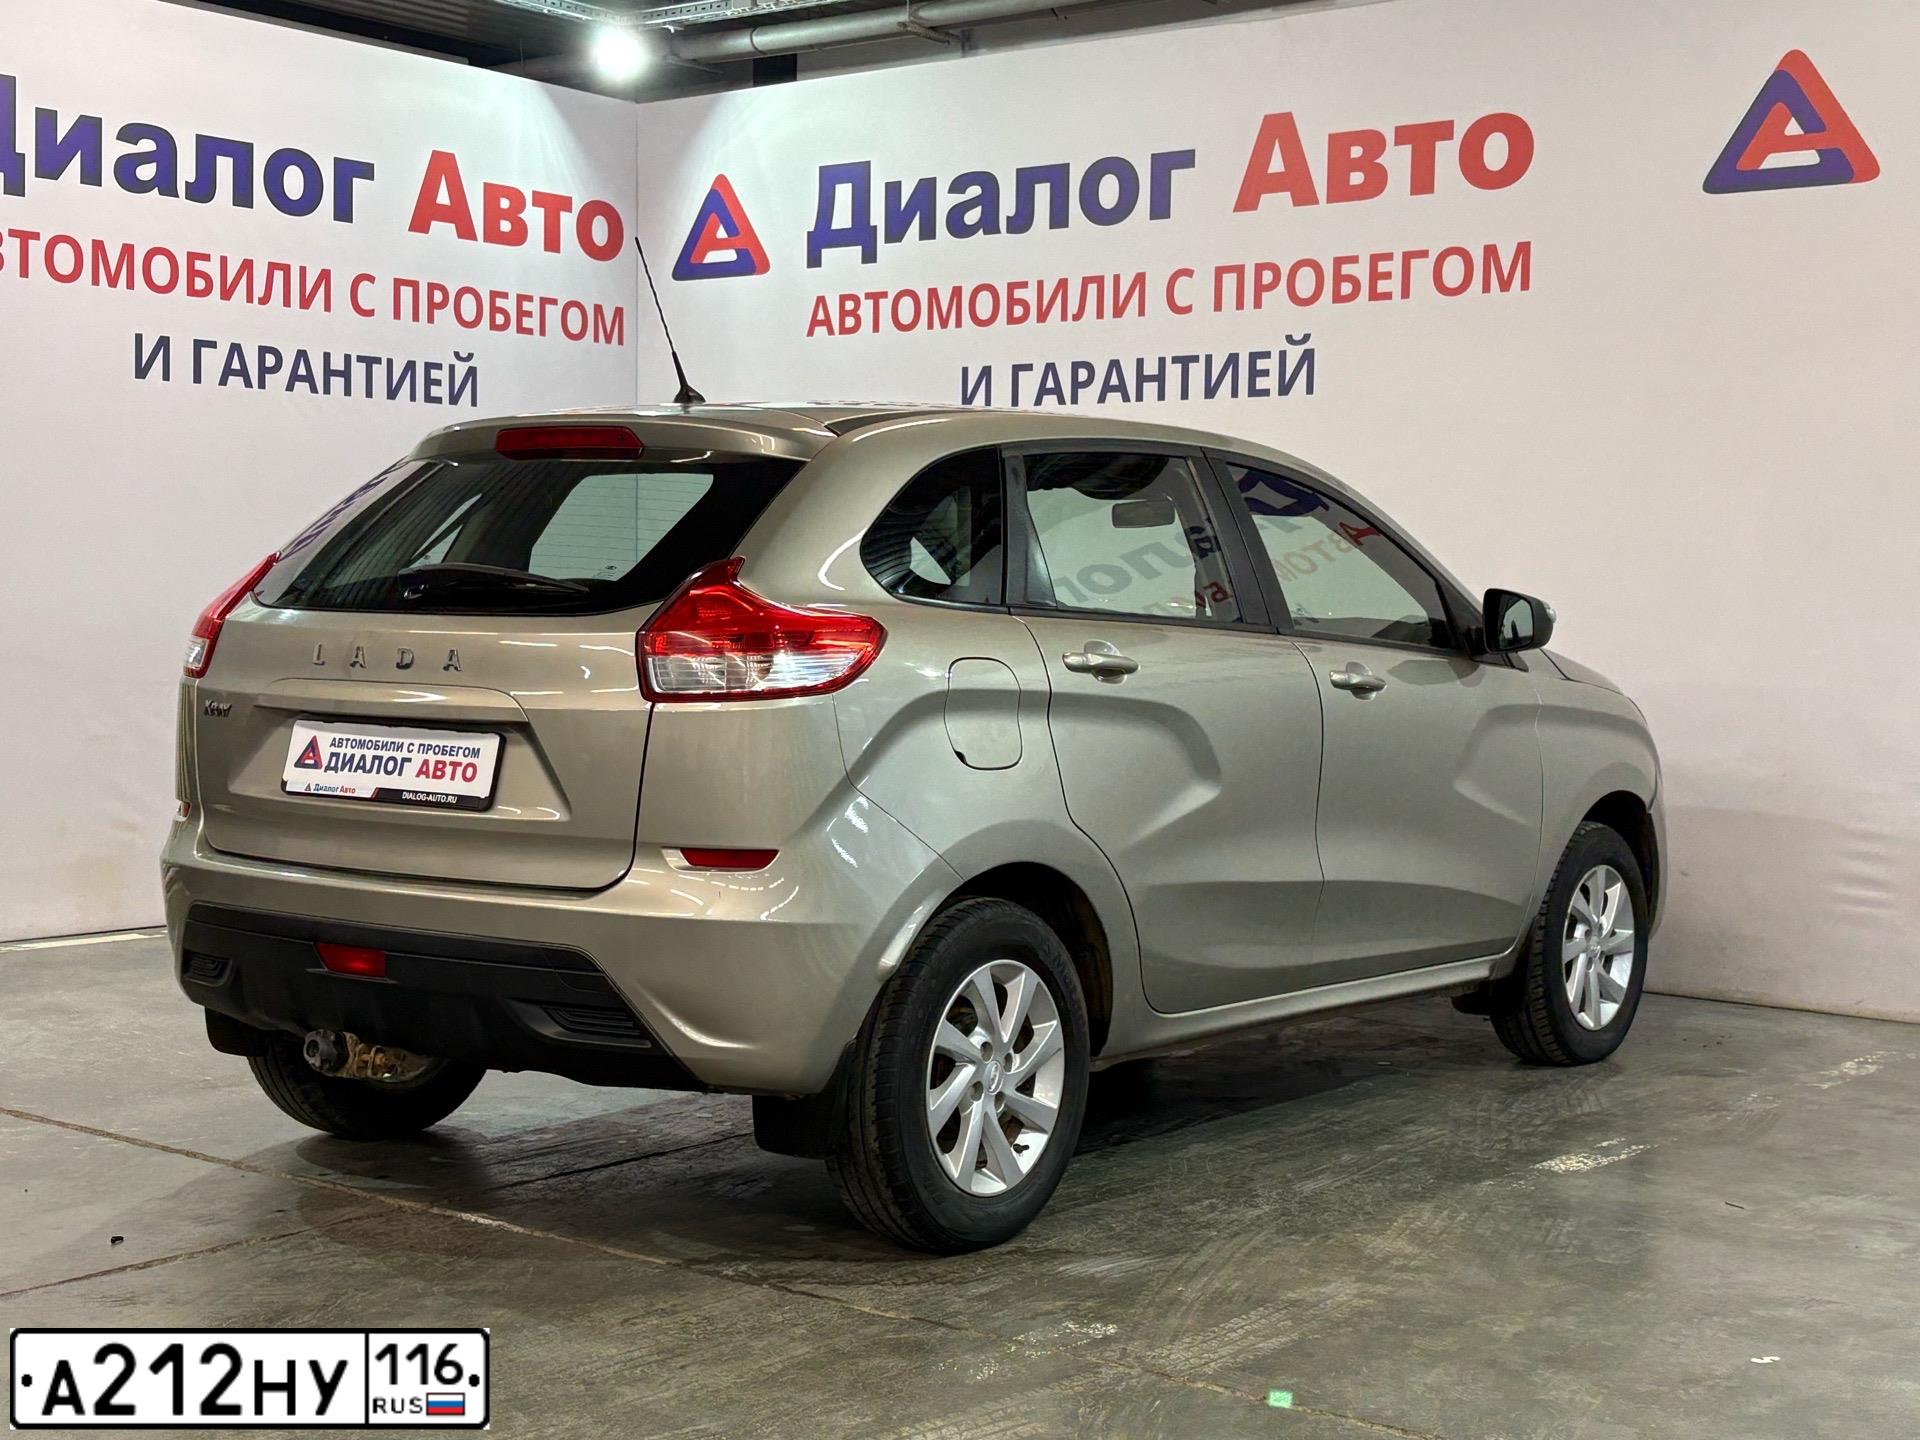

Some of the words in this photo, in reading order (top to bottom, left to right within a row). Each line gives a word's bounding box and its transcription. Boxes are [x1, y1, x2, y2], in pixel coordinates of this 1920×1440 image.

[408, 150, 625, 262] Авто
[806, 149, 1196, 268] Диалог
[1233, 112, 1535, 213] Авто
[0, 228, 332, 313] ТОМОБИЛИ
[350, 273, 376, 318] С
[393, 277, 624, 346] ПРОБЕГОМ
[806, 271, 1147, 338] АВТОМОБИЛИ
[1166, 268, 1194, 316] С
[1213, 240, 1532, 313] ПРОБЕГОМ
[134, 332, 170, 382] И
[192, 339, 479, 408] ГАРАНТИЕЙ
[961, 365, 992, 406] И
[1010, 333, 1315, 407] ГАРАНТИЕЙ
[312, 643, 462, 672] LADA
[323, 752, 412, 777] ДИАЛОГ
[415, 759, 478, 783] АВТО
[329, 737, 404, 753] АВТОМОБИЛИ
[407, 742, 415, 752] С
[417, 743, 481, 759] ПРОБЕГОМ
[313, 783, 339, 794] Диалог
[339, 785, 356, 794] Авто
[402, 791, 458, 804] DIALOG-AUTO.RU
